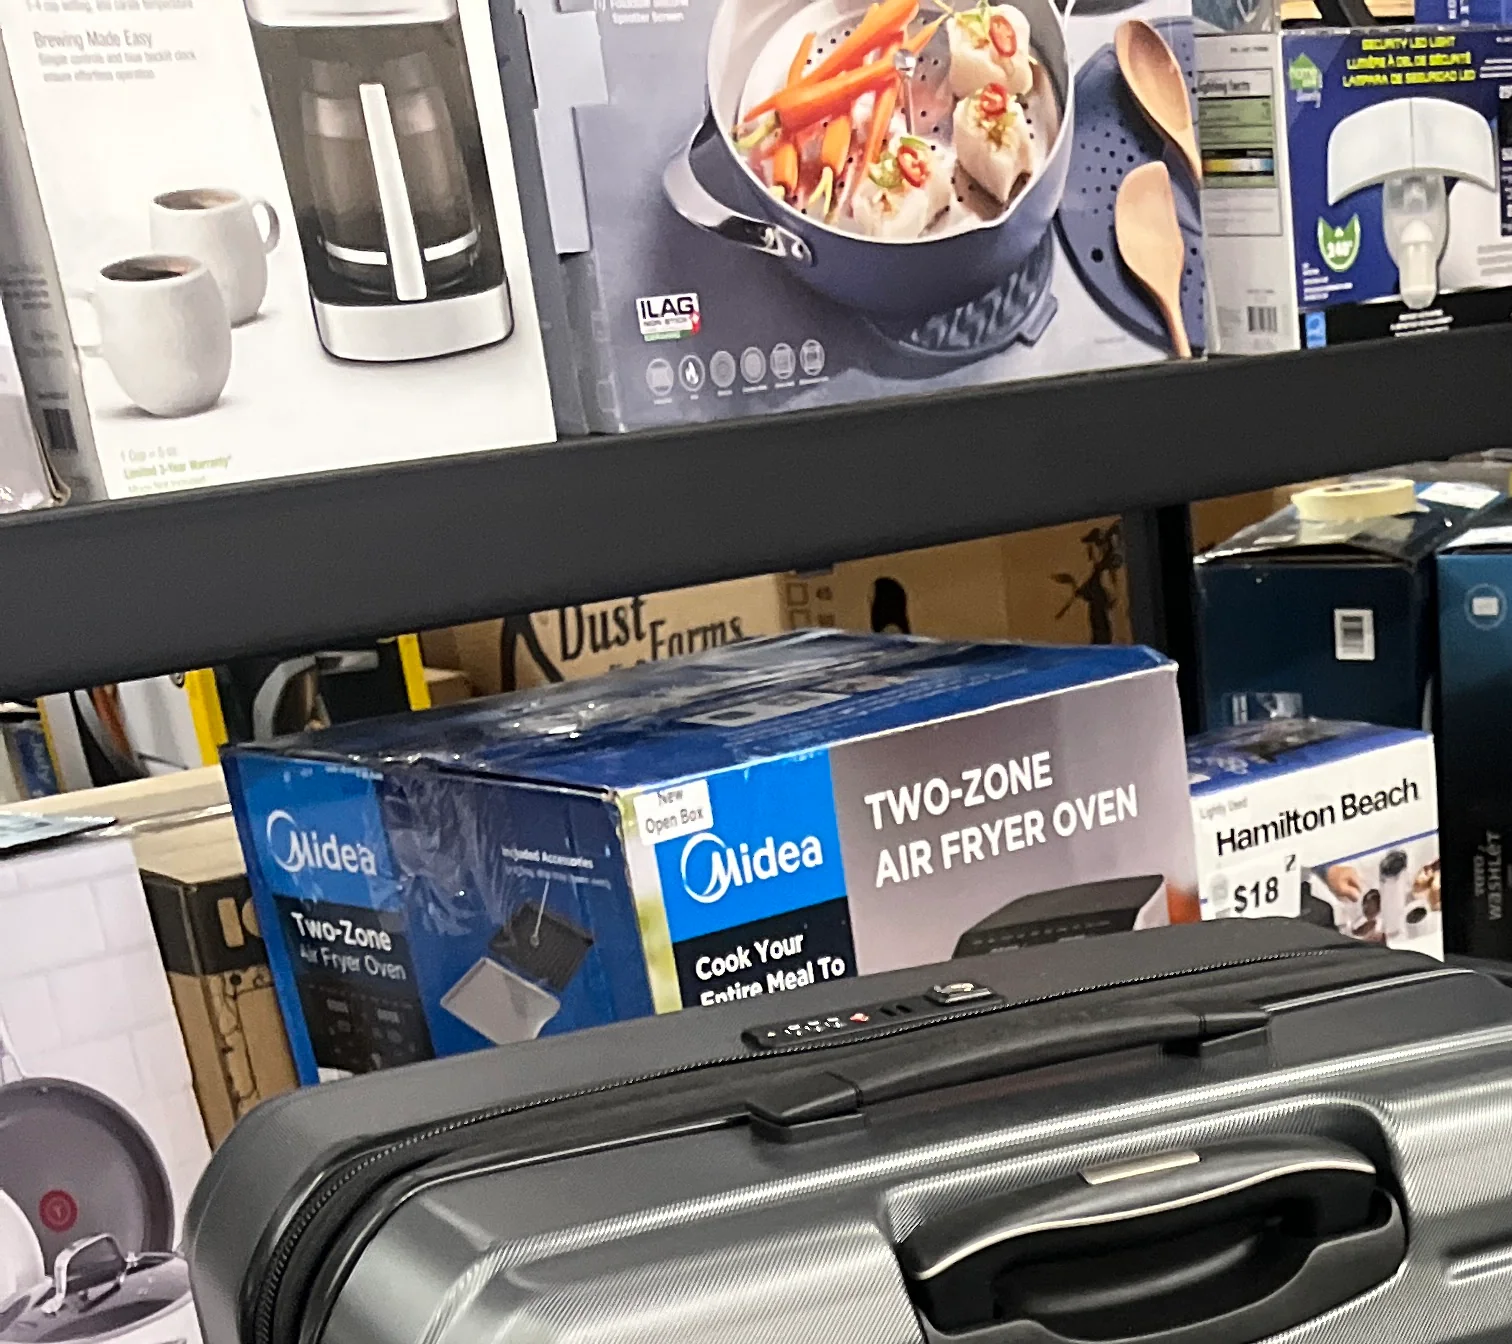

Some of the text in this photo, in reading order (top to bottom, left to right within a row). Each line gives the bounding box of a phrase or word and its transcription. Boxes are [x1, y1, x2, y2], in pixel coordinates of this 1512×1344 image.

[33, 29, 153, 50] Brewing Made Easy
[1408, 36, 1428, 49] LED
[1428, 35, 1456, 48] LIGHT
[640, 296, 695, 320] ILAG
[558, 594, 648, 662] Dust
[656, 788, 684, 807] New
[863, 750, 1053, 831] TWO-ZONE
[645, 807, 705, 836] Open Box
[875, 783, 1139, 889] AIR FRYER OVEN
[1215, 777, 1419, 857] Hamilton Beach
[265, 809, 378, 877] Midea
[680, 831, 824, 904] Midea
[1233, 875, 1280, 914] $18
[289, 911, 392, 952] Two-Zone
[319, 949, 361, 977] Fryer
[363, 956, 407, 981] Oven
[695, 934, 804, 981] Cook Your
[700, 956, 846, 1008] Entire Meal To
